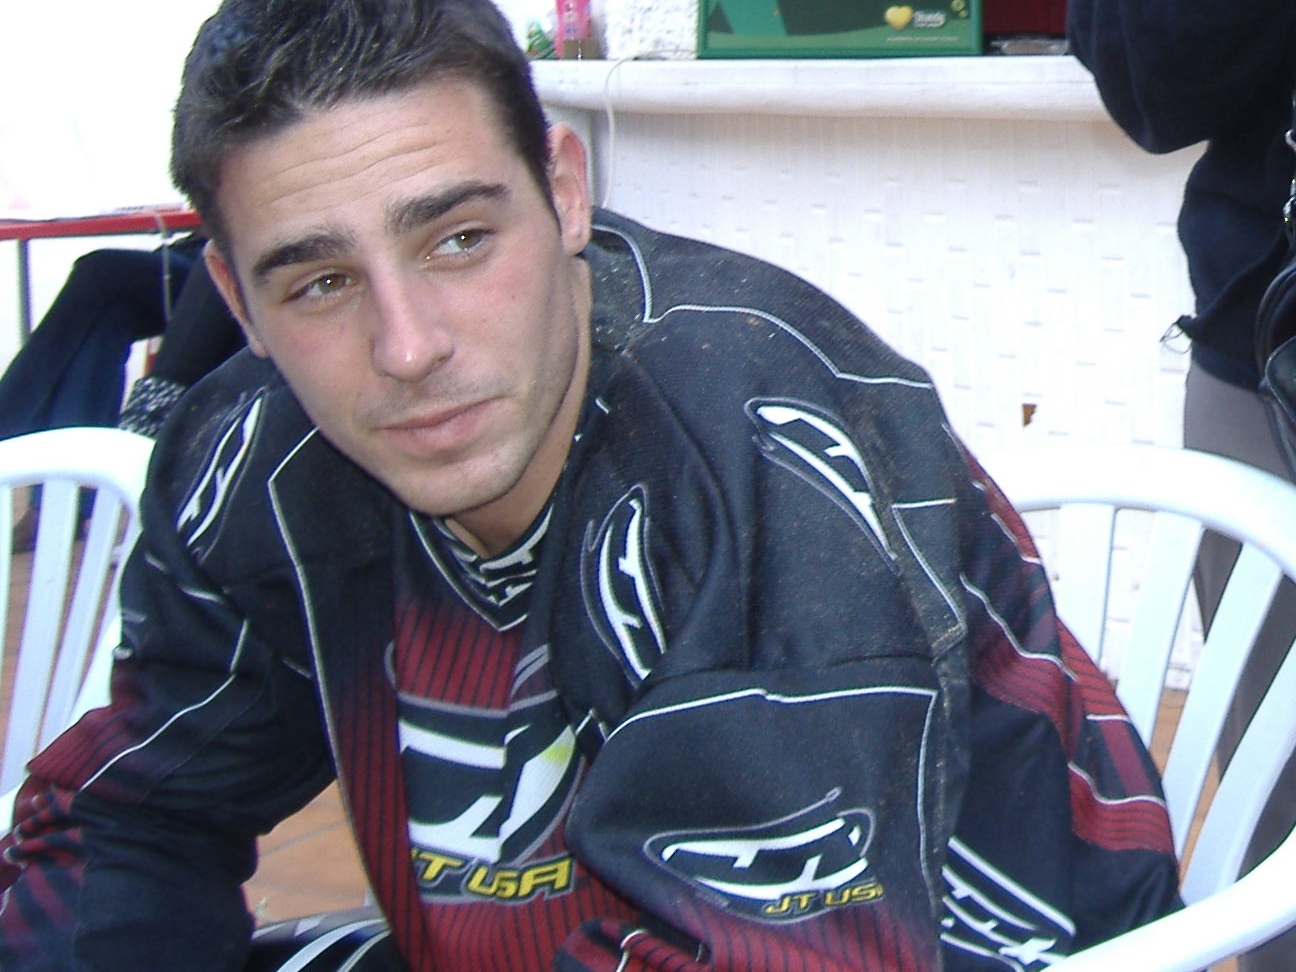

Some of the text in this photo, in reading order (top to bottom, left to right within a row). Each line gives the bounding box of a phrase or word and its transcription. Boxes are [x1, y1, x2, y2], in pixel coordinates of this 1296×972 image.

[467, 857, 573, 899] USA
[763, 882, 884, 915] JT US
